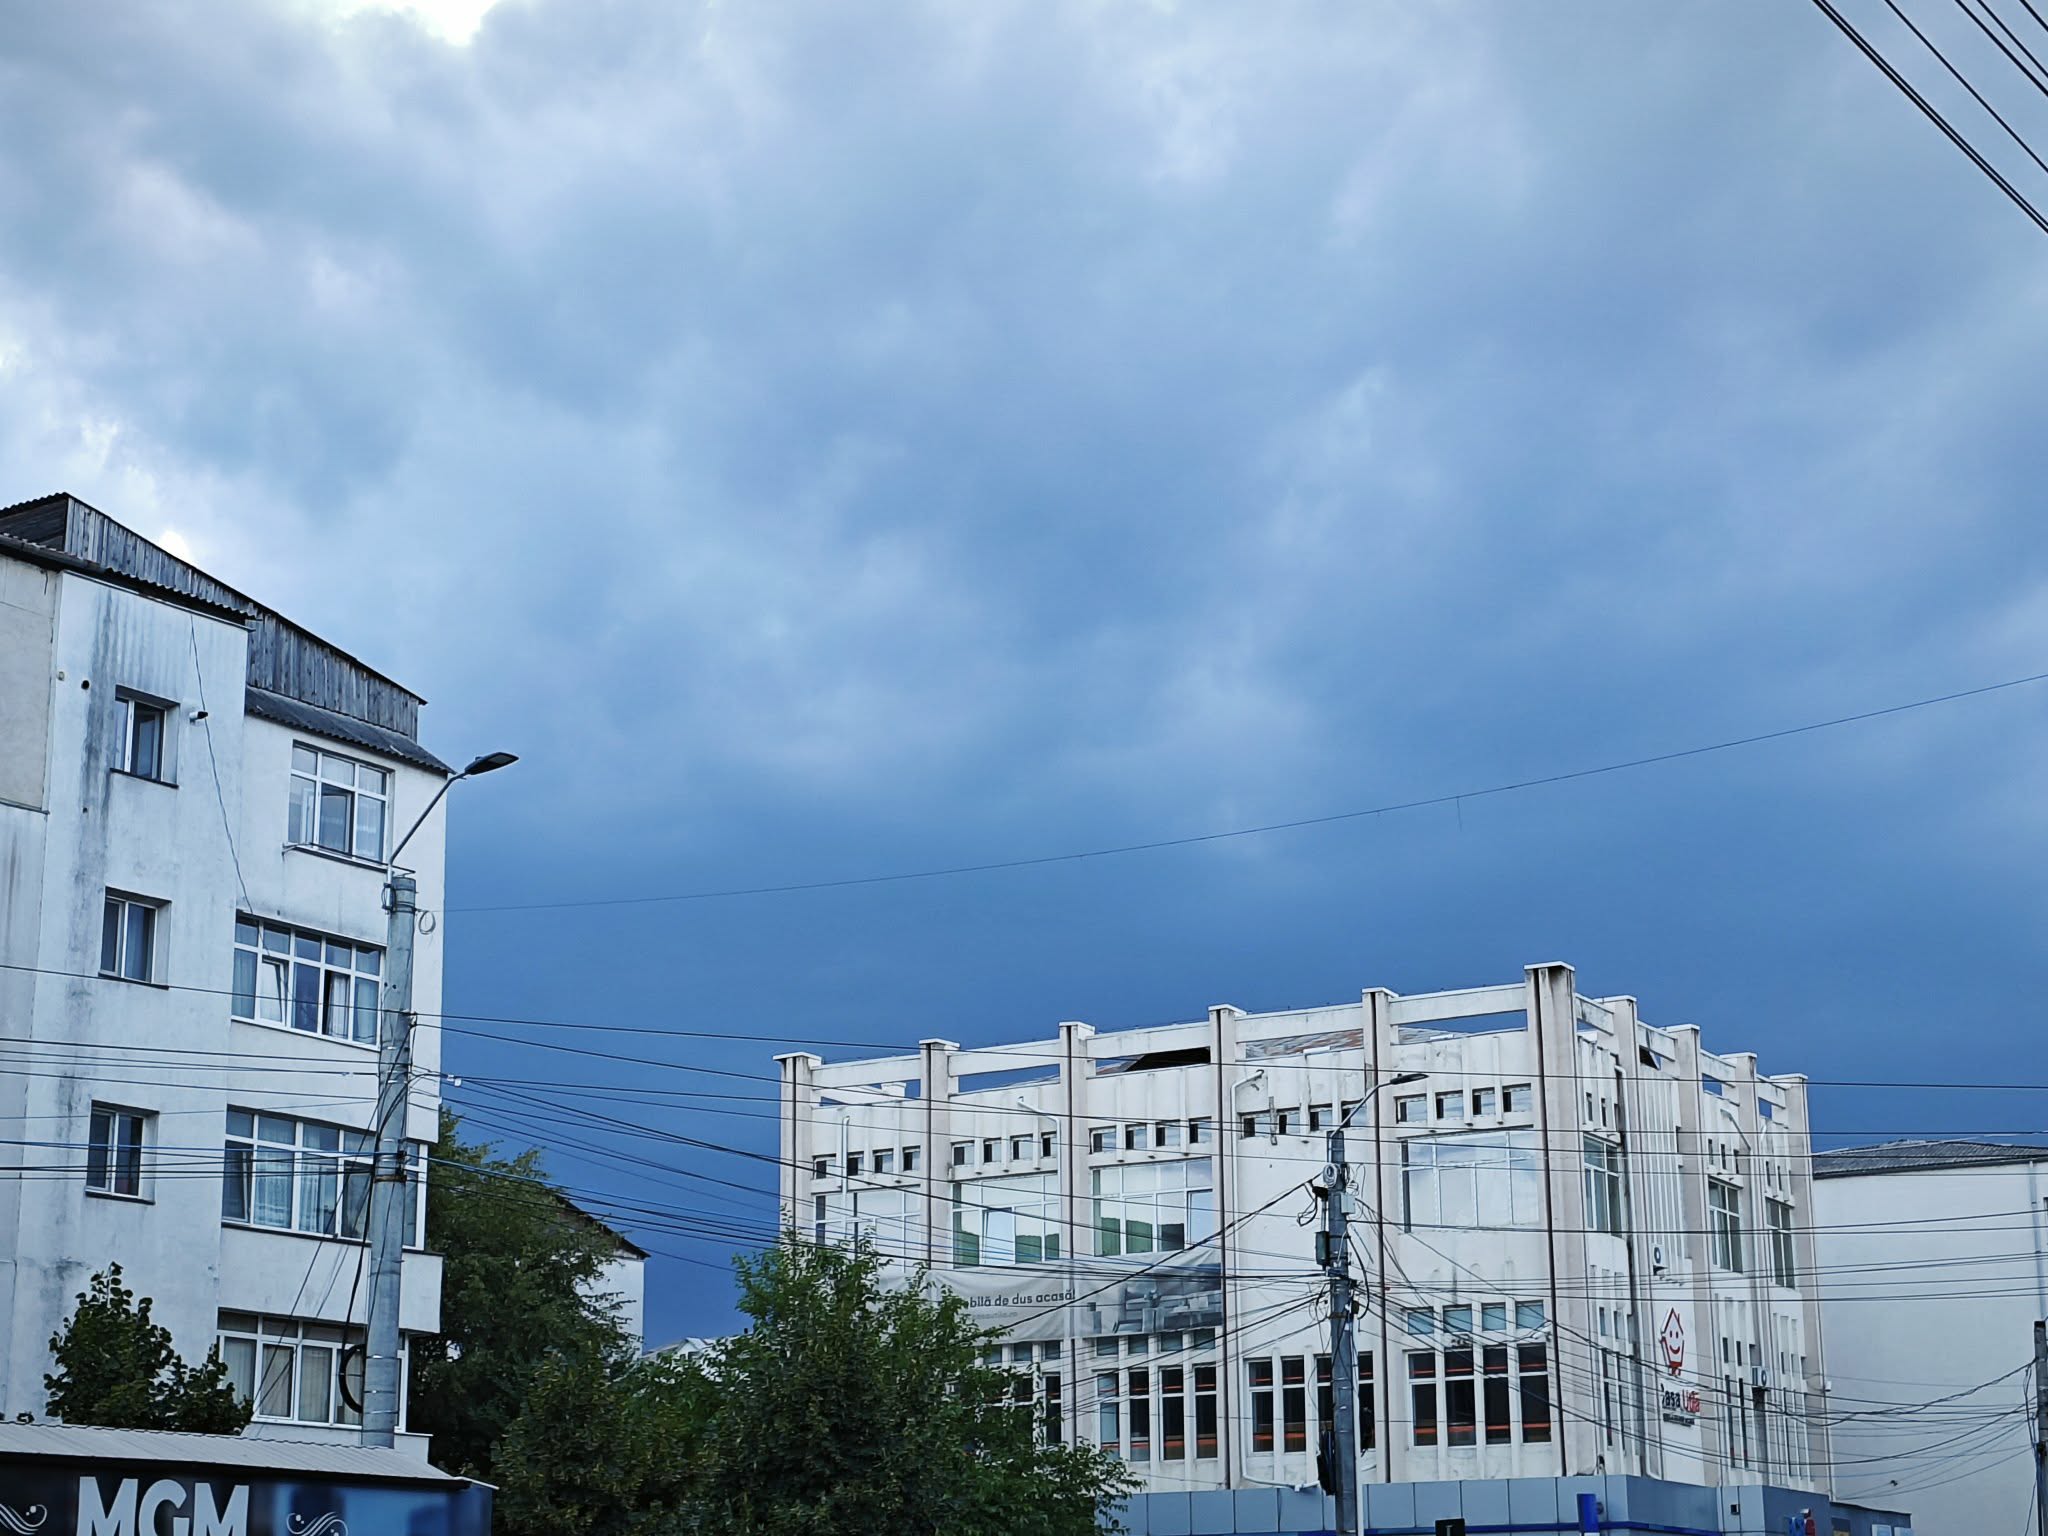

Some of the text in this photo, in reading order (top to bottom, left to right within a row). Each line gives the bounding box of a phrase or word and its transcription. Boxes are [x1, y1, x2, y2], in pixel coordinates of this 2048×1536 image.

[994, 1294, 1009, 1307] de
[1012, 1292, 1033, 1305] dus
[1035, 1288, 1076, 1303] acasă!
[76, 1476, 250, 1536] MGM
